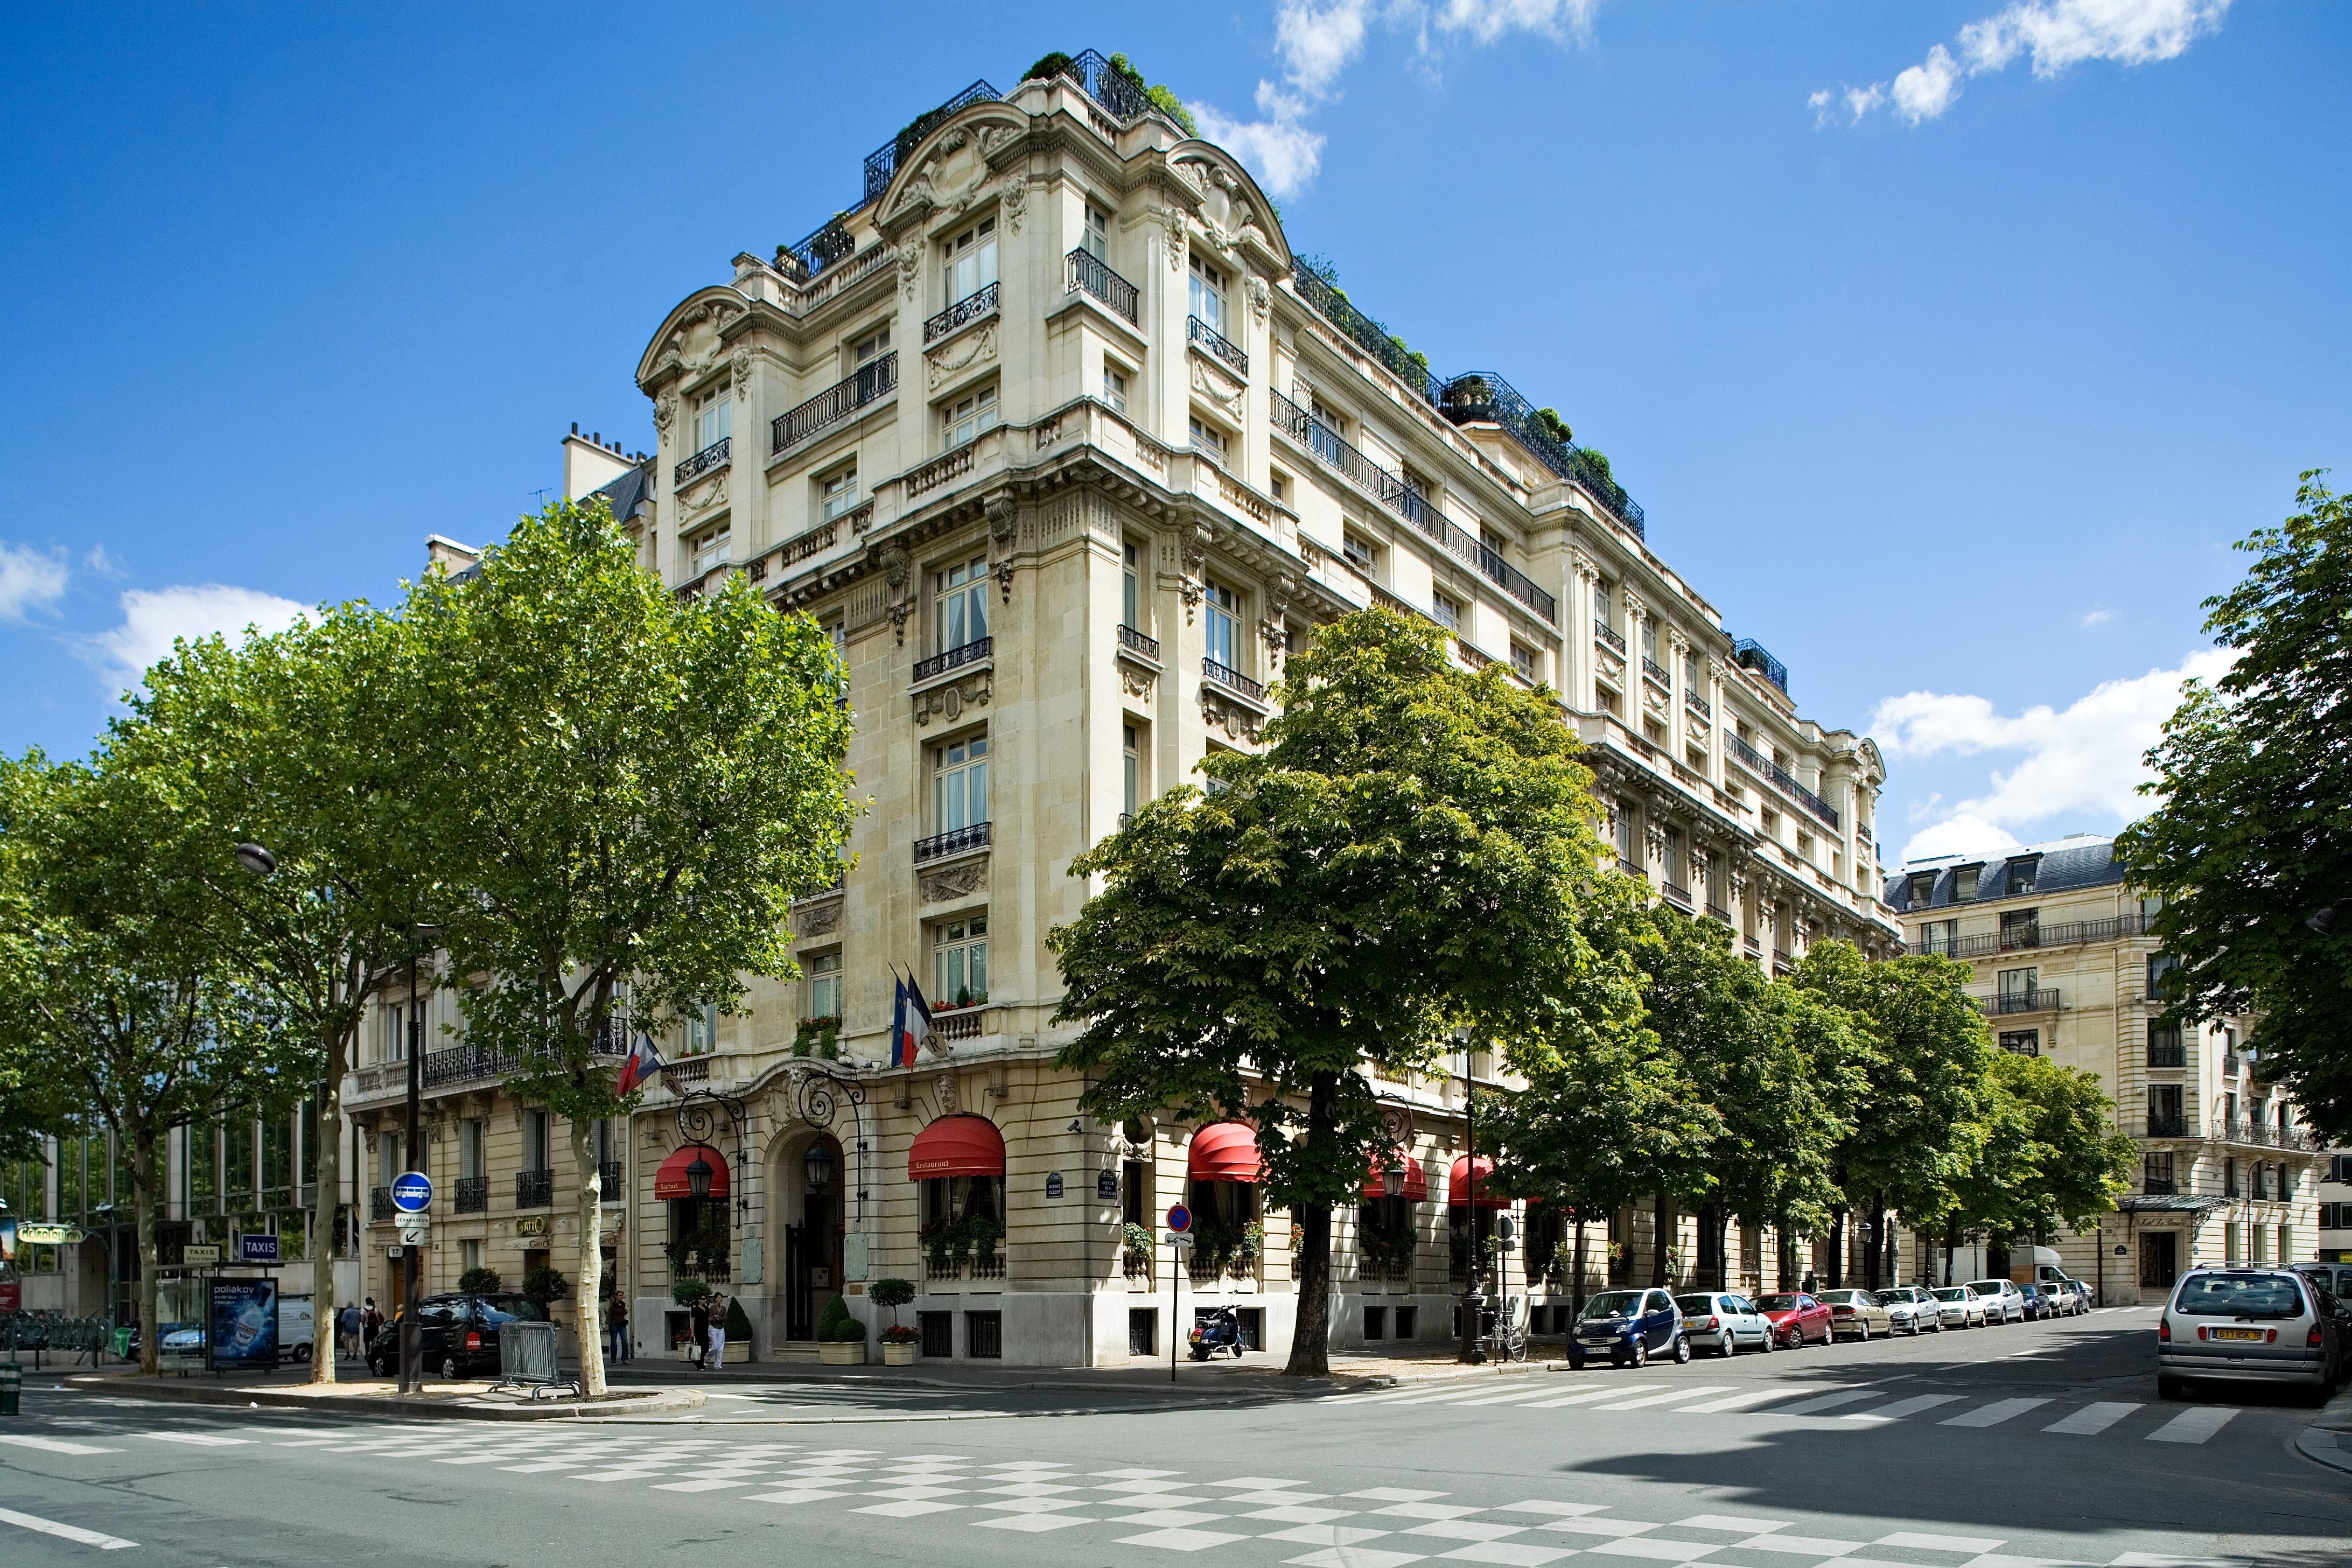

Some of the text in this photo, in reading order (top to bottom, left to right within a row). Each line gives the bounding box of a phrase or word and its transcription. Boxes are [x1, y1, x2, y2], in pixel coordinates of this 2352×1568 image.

[926, 1035, 942, 1052] R
[666, 1079, 681, 1093] R
[915, 1160, 949, 1168] Restaurant
[660, 1182, 678, 1191] Raphael
[246, 1242, 276, 1253] TAXIS
[214, 1285, 255, 1293] poliakov
